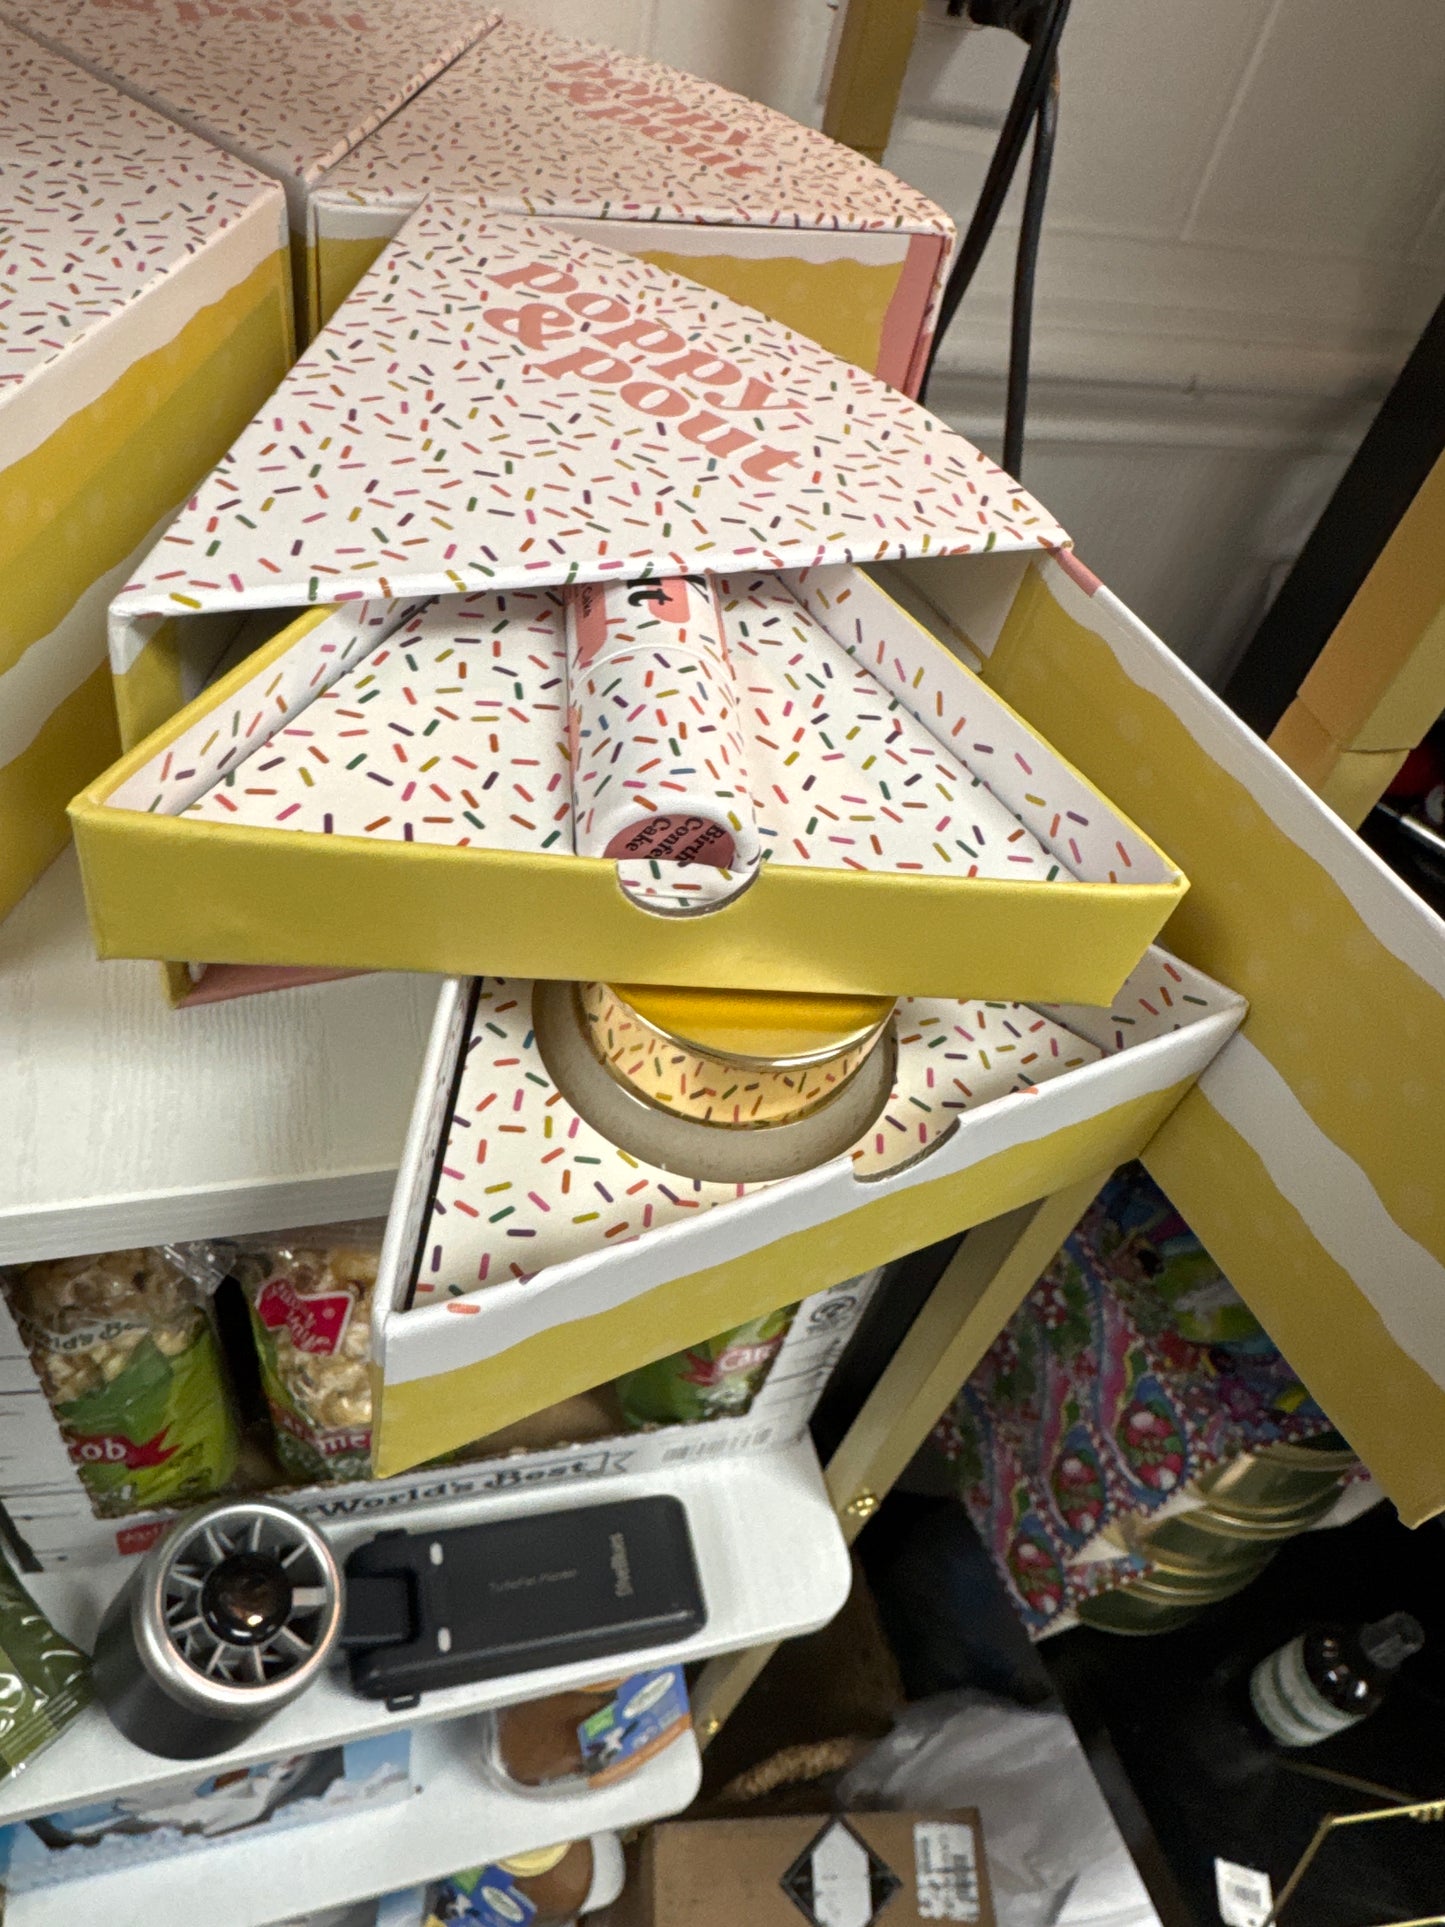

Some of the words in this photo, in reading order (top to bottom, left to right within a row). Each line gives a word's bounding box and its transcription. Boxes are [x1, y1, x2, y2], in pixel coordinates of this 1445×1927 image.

[485, 261, 809, 411] poppy
[483, 302, 576, 351] &
[531, 346, 804, 483] pout
[625, 816, 671, 851] Cake
[314, 1479, 475, 1518] World's
[482, 1458, 588, 1490] Best
